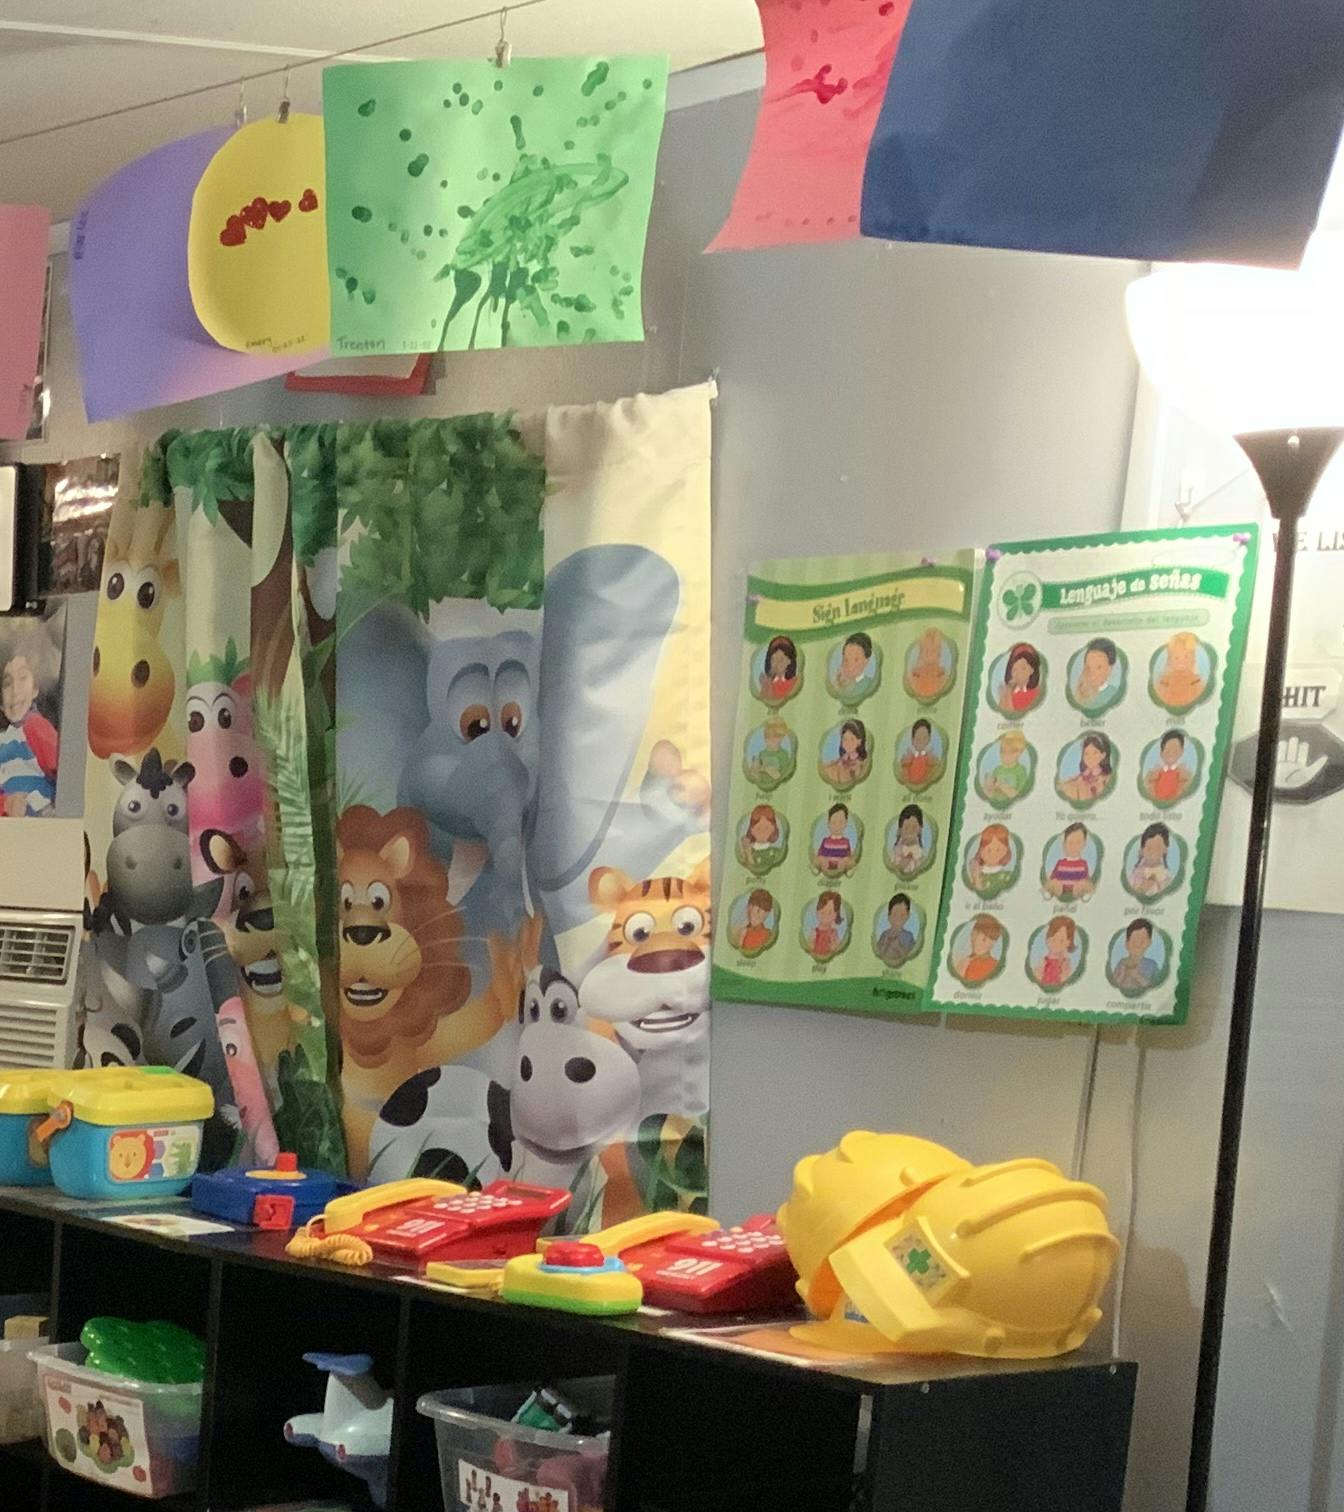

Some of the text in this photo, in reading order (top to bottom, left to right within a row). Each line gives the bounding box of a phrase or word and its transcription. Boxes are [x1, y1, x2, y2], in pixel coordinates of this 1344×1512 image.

[336, 336, 386, 350] Trenton
[1060, 581, 1127, 605] Lenguaje
[1130, 578, 1145, 592] de
[811, 588, 906, 625] Sign Language
[665, 1258, 724, 1276] 911
